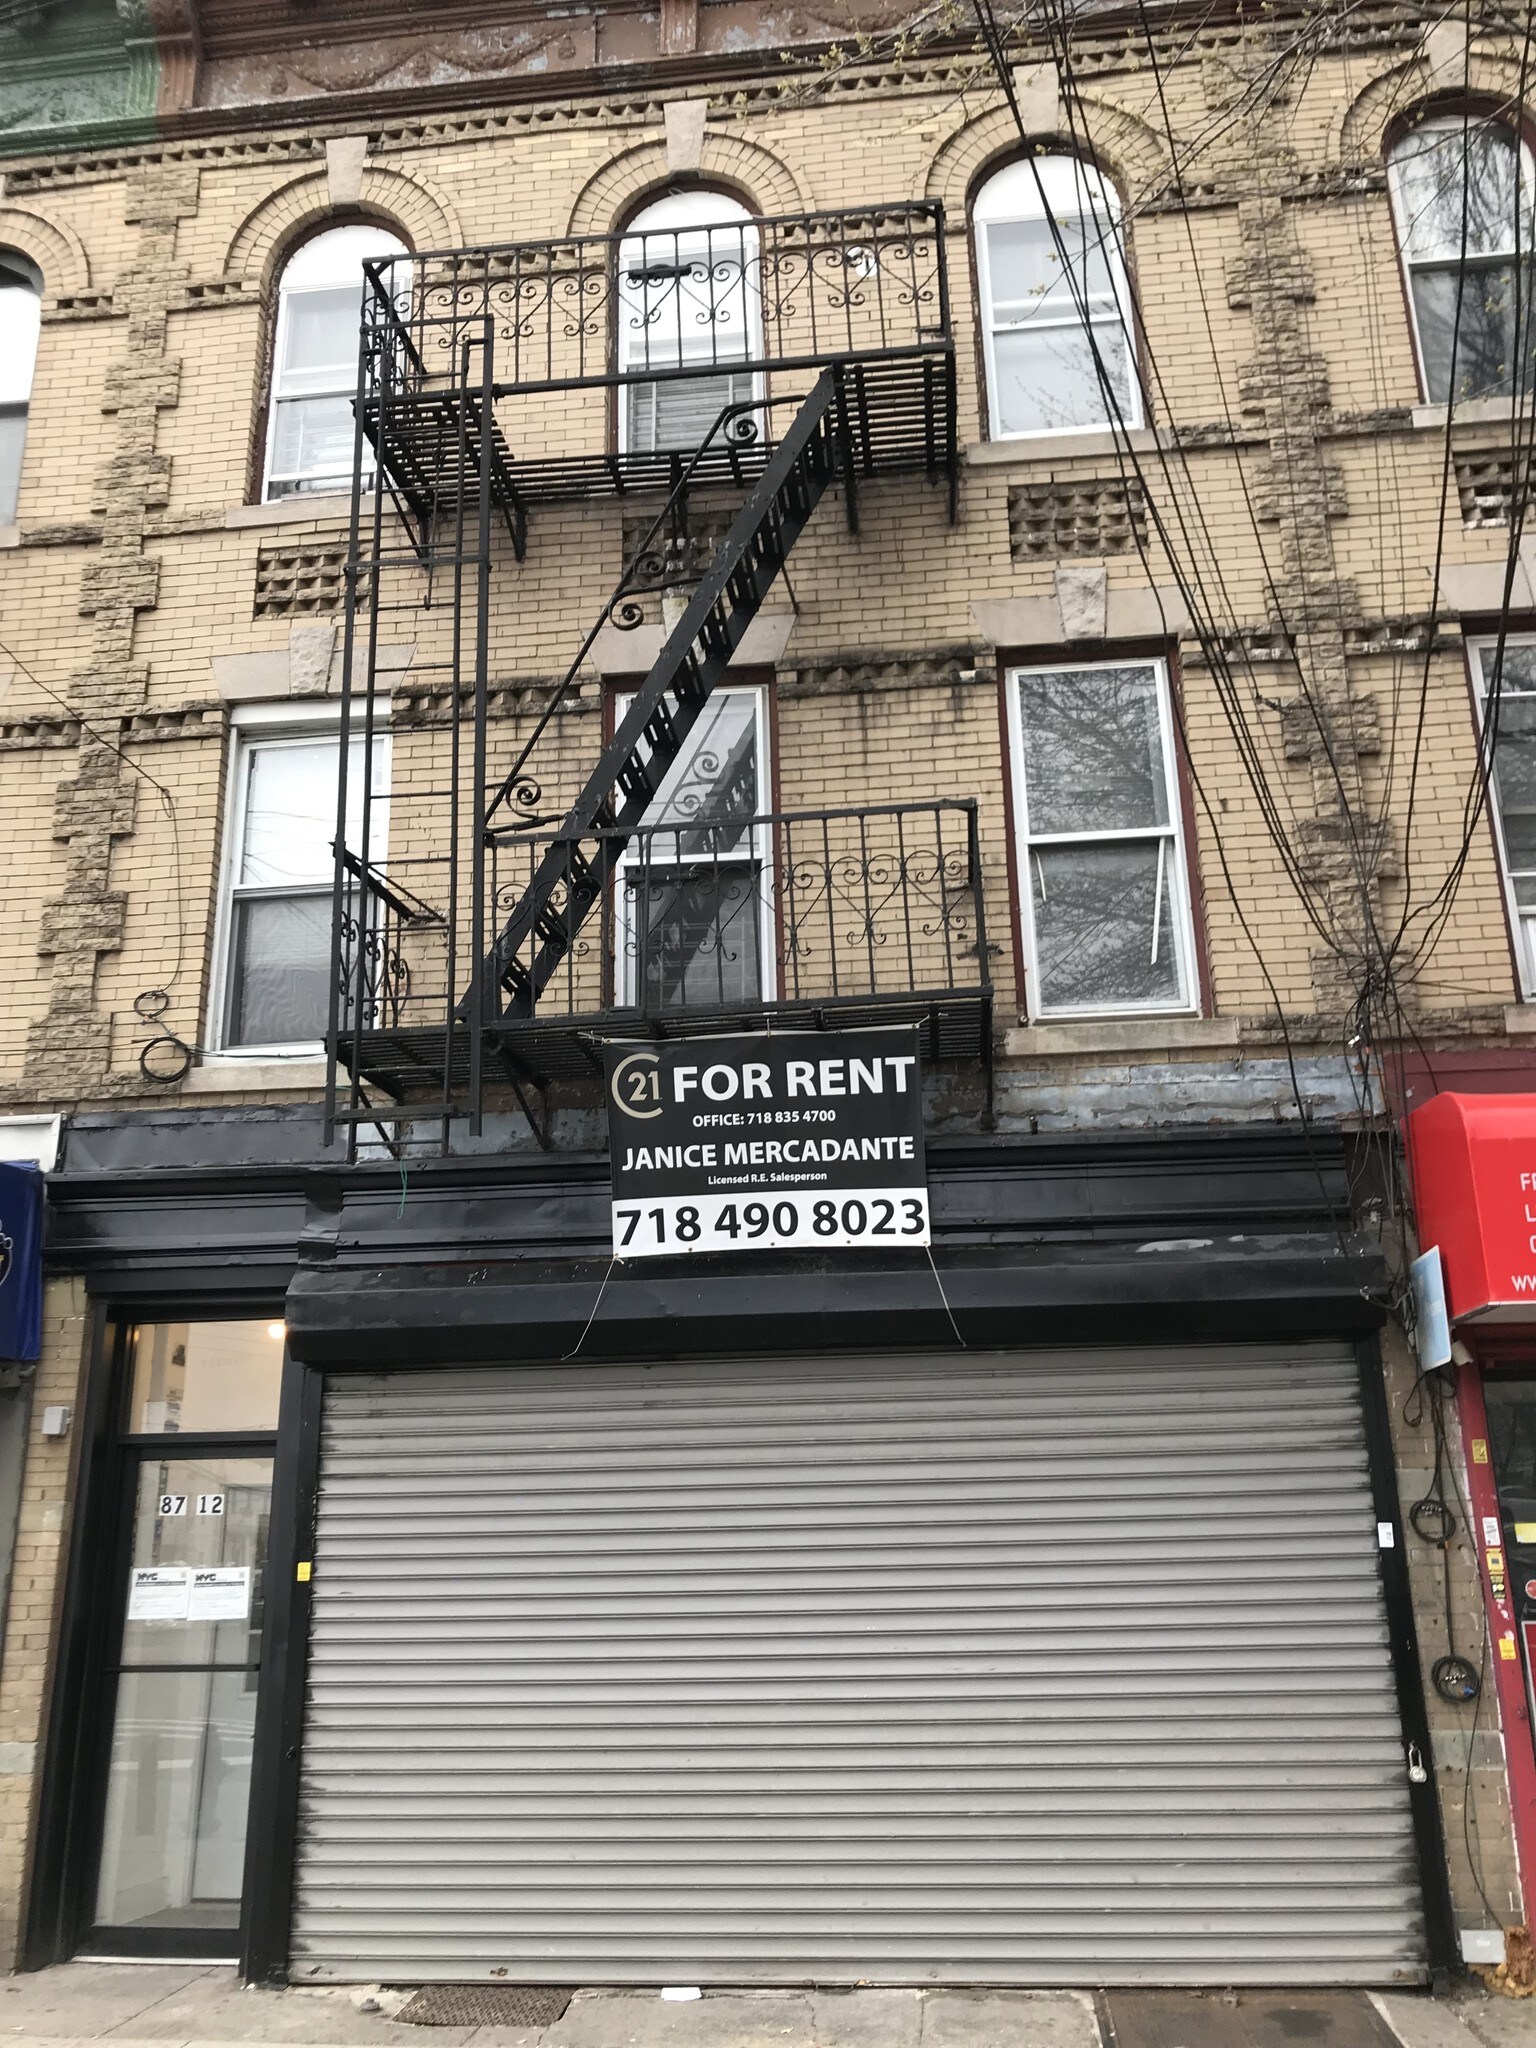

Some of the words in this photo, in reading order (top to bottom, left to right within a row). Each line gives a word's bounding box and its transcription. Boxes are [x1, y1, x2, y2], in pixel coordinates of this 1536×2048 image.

[673, 1062, 774, 1103] FOR
[786, 1055, 916, 1097] RENT
[692, 1112, 745, 1127] OFFICE:
[746, 1111, 773, 1126] 718
[774, 1110, 800, 1123] 835
[802, 1109, 837, 1122] 4700
[621, 1143, 718, 1171] JANICE
[724, 1136, 915, 1166] MERCADANTE
[707, 1173, 750, 1185] Licensed
[751, 1173, 769, 1183] R.E.
[770, 1172, 828, 1183] Salesperson
[616, 1205, 702, 1247] 718
[714, 1201, 799, 1239] 490
[812, 1198, 925, 1236] 8023
[161, 1496, 186, 1514] 87
[199, 1495, 223, 1513] 12
